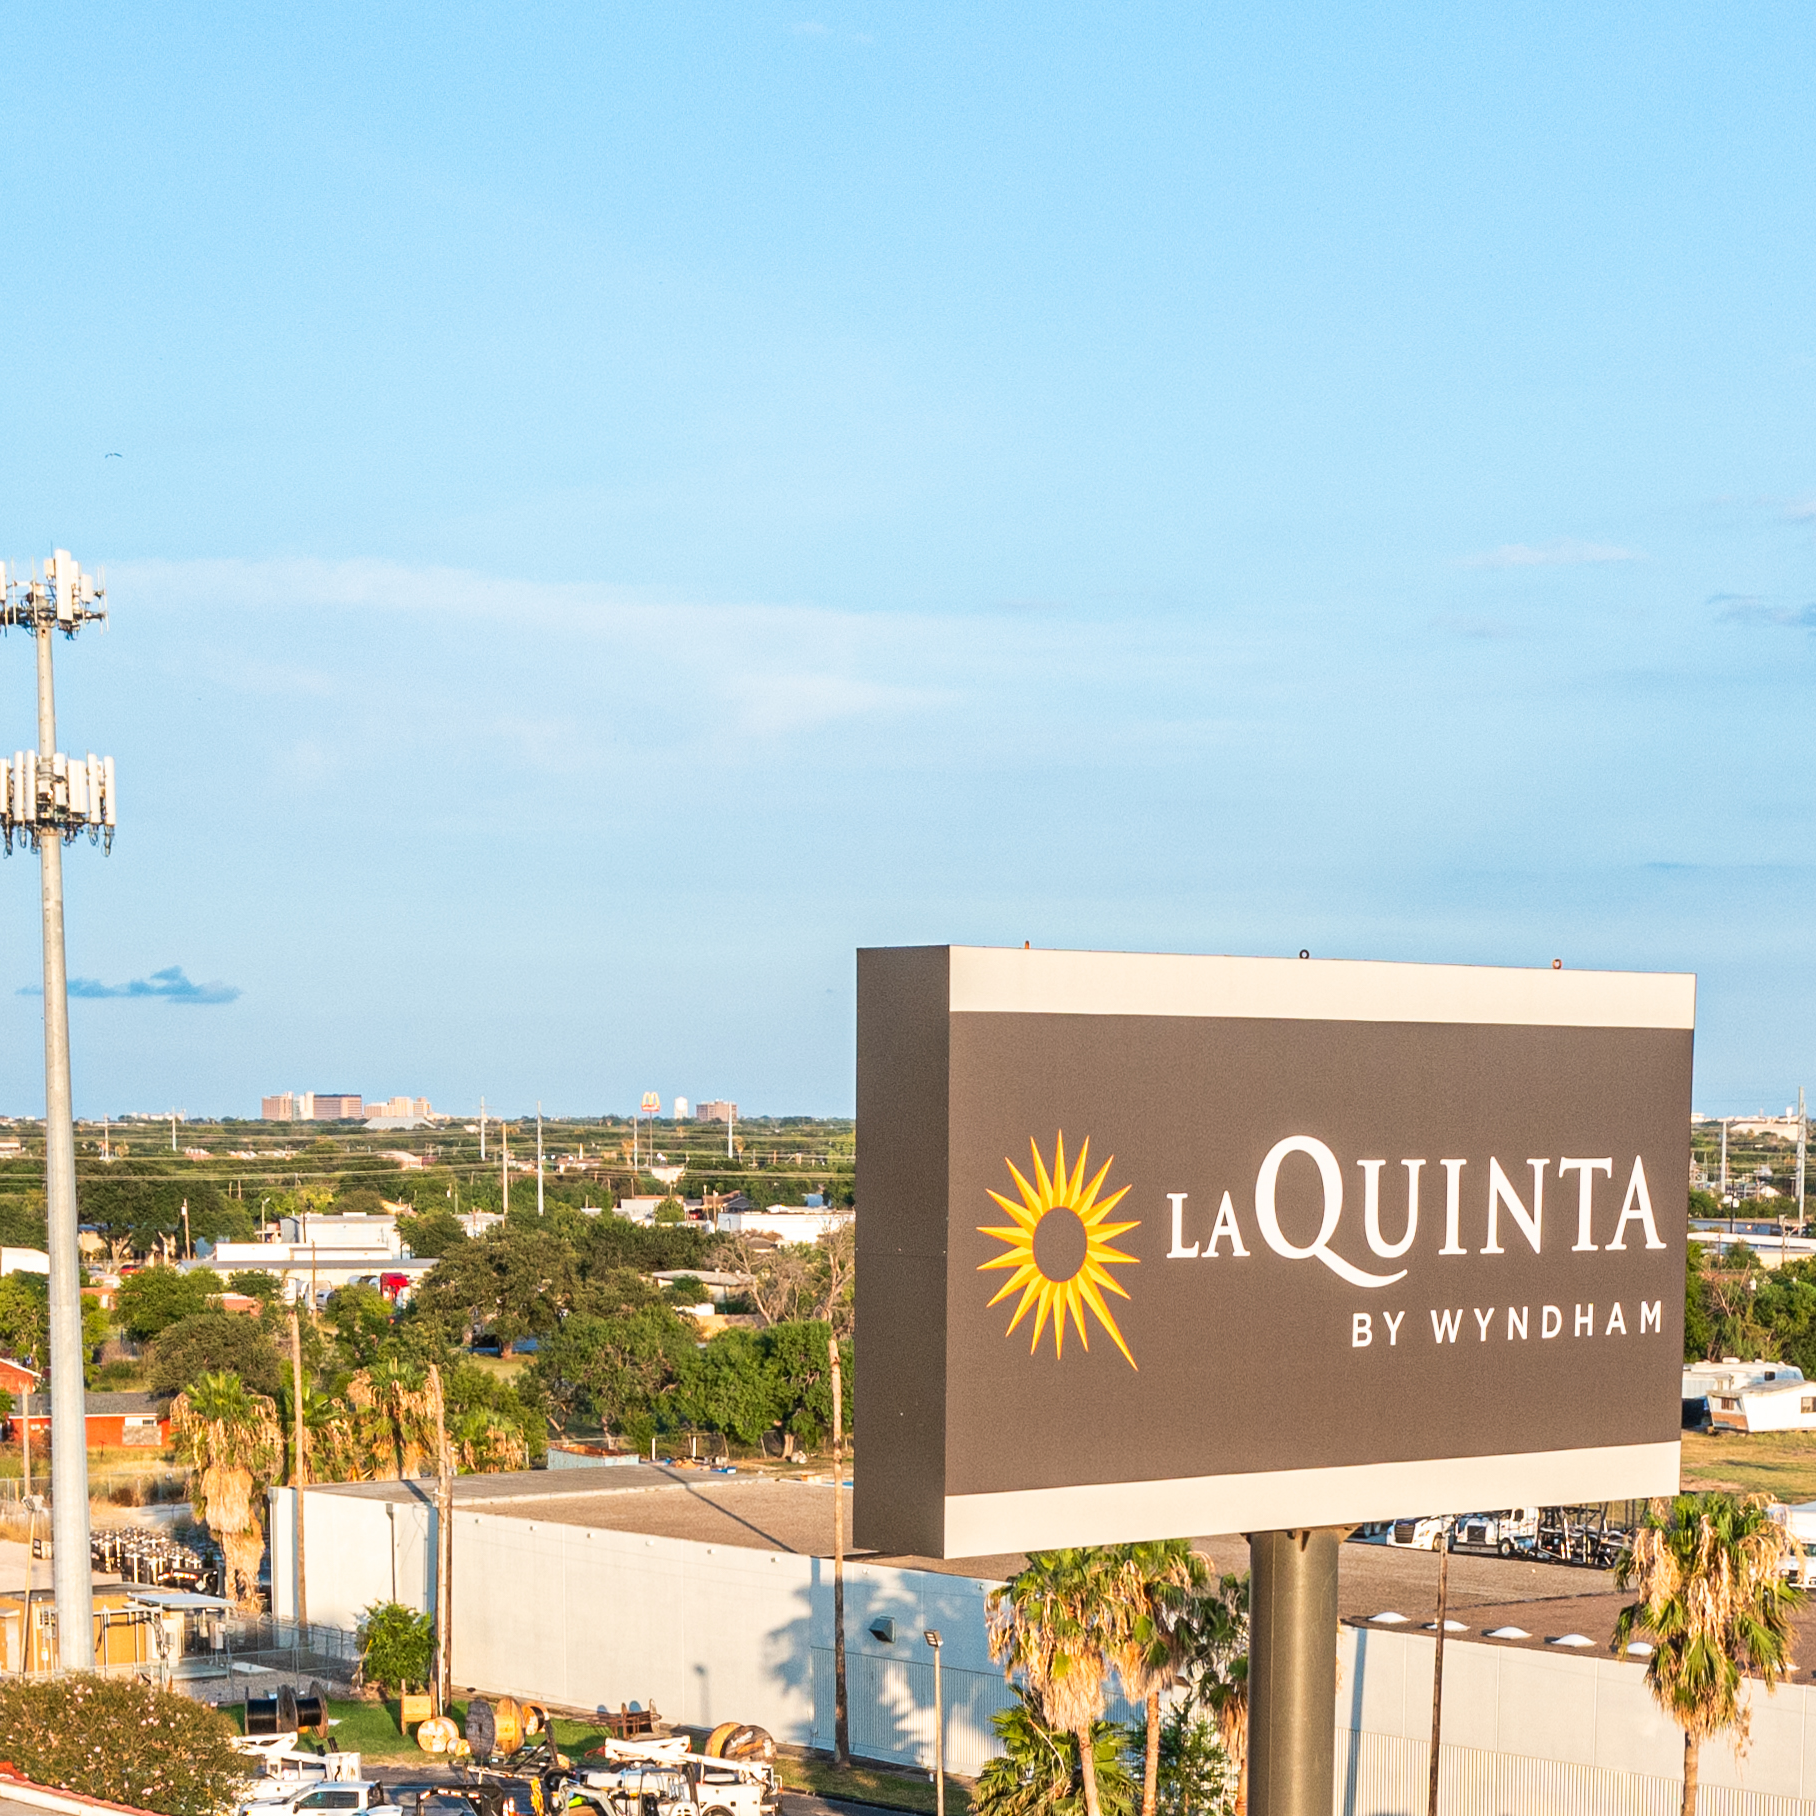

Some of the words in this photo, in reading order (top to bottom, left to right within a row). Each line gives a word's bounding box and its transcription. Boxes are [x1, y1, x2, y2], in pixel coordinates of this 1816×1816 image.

[1165, 1190, 1250, 1260] LA
[1255, 1134, 1667, 1289] QUINTA
[1351, 1310, 1404, 1348] BY
[1430, 1299, 1664, 1346] WYNDHAM
